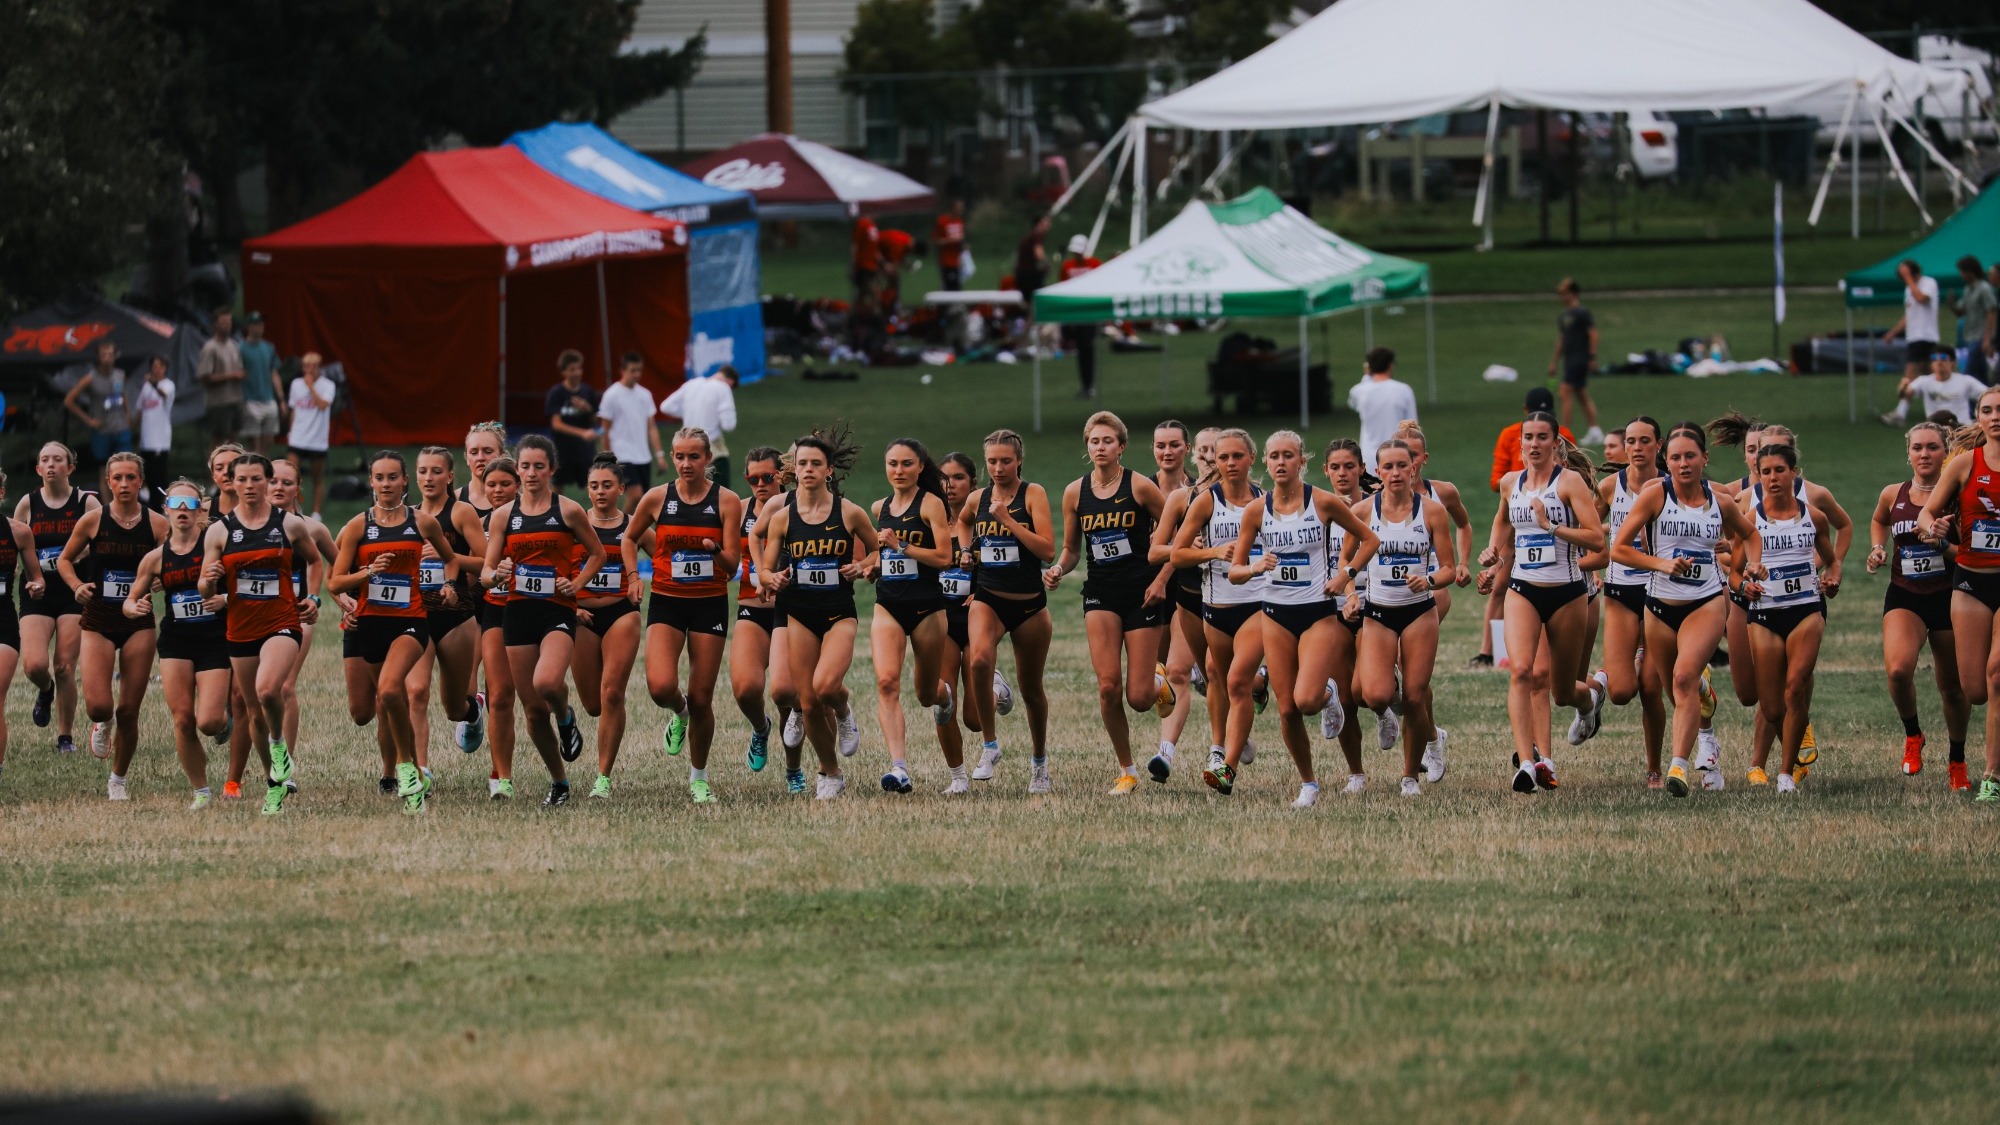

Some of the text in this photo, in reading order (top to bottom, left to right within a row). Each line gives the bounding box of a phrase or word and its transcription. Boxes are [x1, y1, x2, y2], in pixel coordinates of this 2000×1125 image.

[1299, 526, 1322, 544] STATE
[1660, 521, 1701, 538] MONTANA
[534, 540, 559, 550] STATE
[1101, 542, 1119, 558] 35
[993, 548, 1006, 561] 31
[1528, 548, 1542, 562] 67
[684, 562, 701, 576] 49
[889, 560, 905, 574] 36
[1391, 565, 1408, 579] 62
[1913, 558, 1931, 572] 52
[592, 574, 608, 587] 44
[809, 571, 826, 584] 40
[1281, 566, 1298, 581] 60
[115, 583, 130, 597] 79
[250, 581, 265, 594] 41
[525, 578, 542, 592] 48
[943, 579, 958, 593] 34
[1784, 578, 1801, 593] 64
[381, 587, 397, 600] 47
